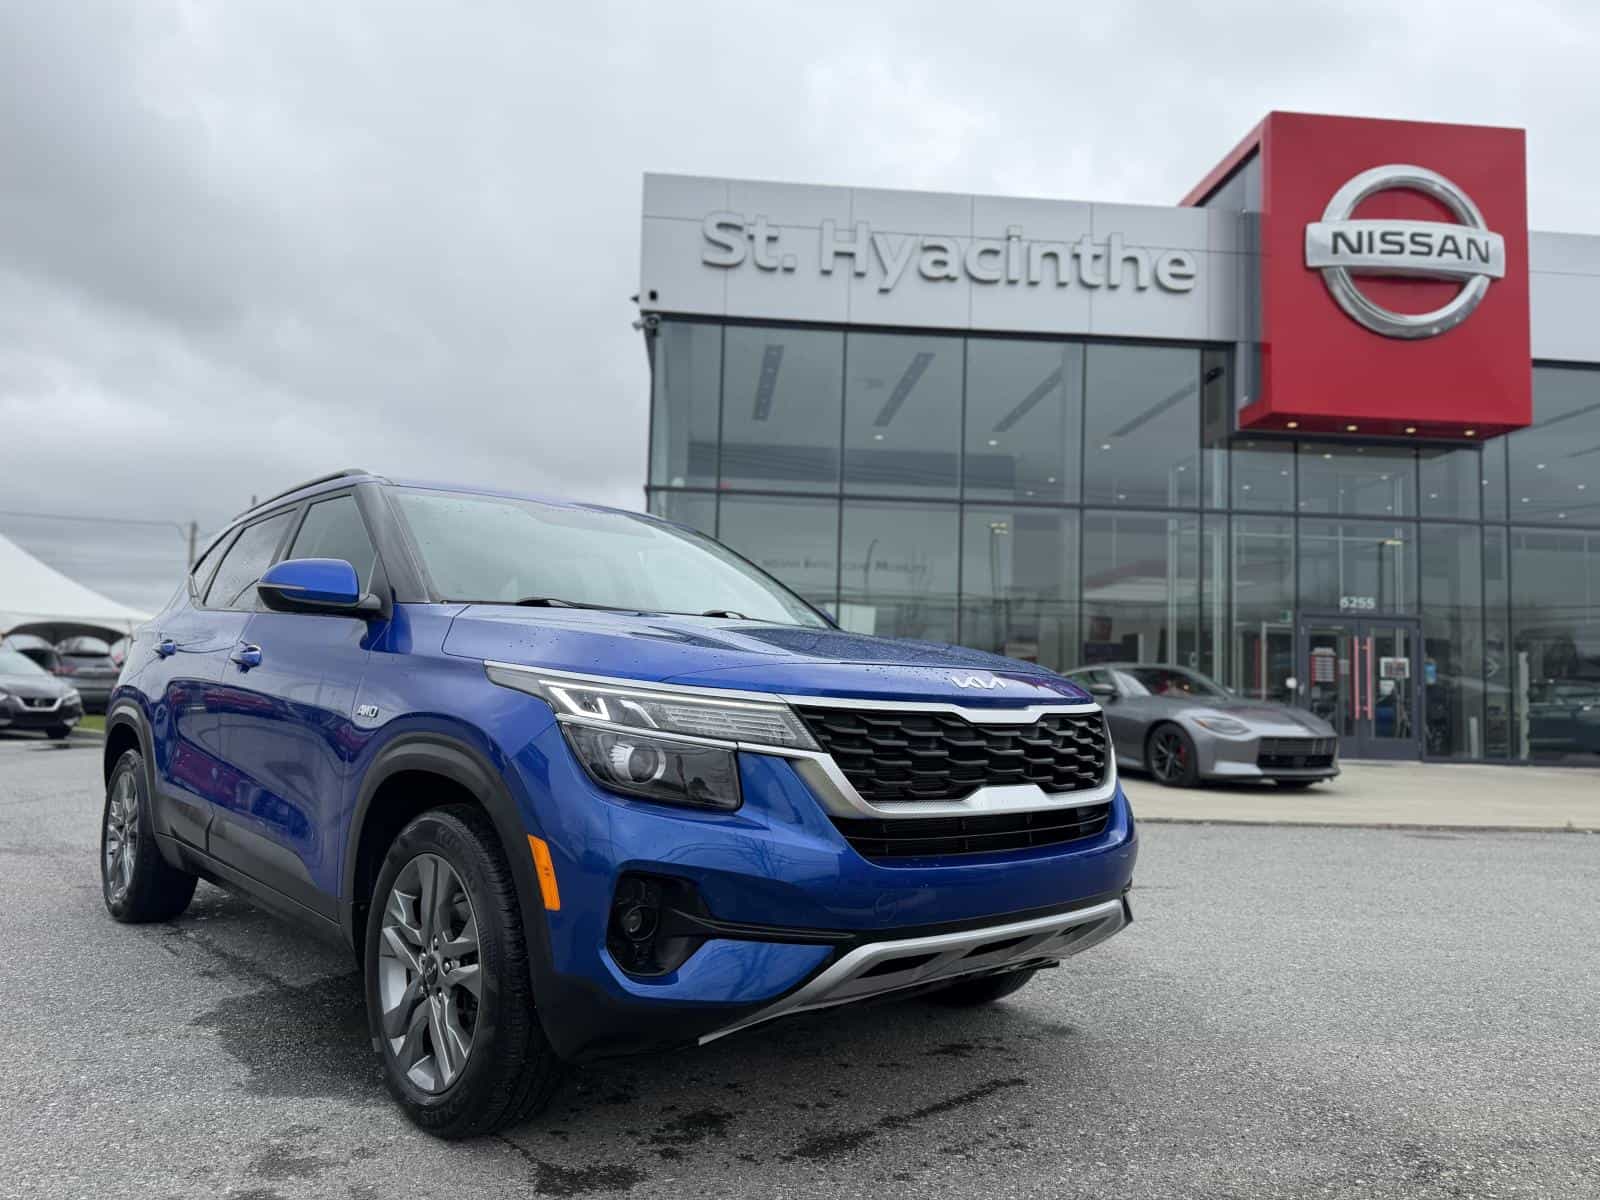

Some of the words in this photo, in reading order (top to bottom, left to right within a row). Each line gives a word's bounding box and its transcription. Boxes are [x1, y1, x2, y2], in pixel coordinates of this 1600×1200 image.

[701, 210, 796, 273] St.
[819, 217, 1197, 294] Hyacinthe
[1331, 230, 1490, 264] NISSAN
